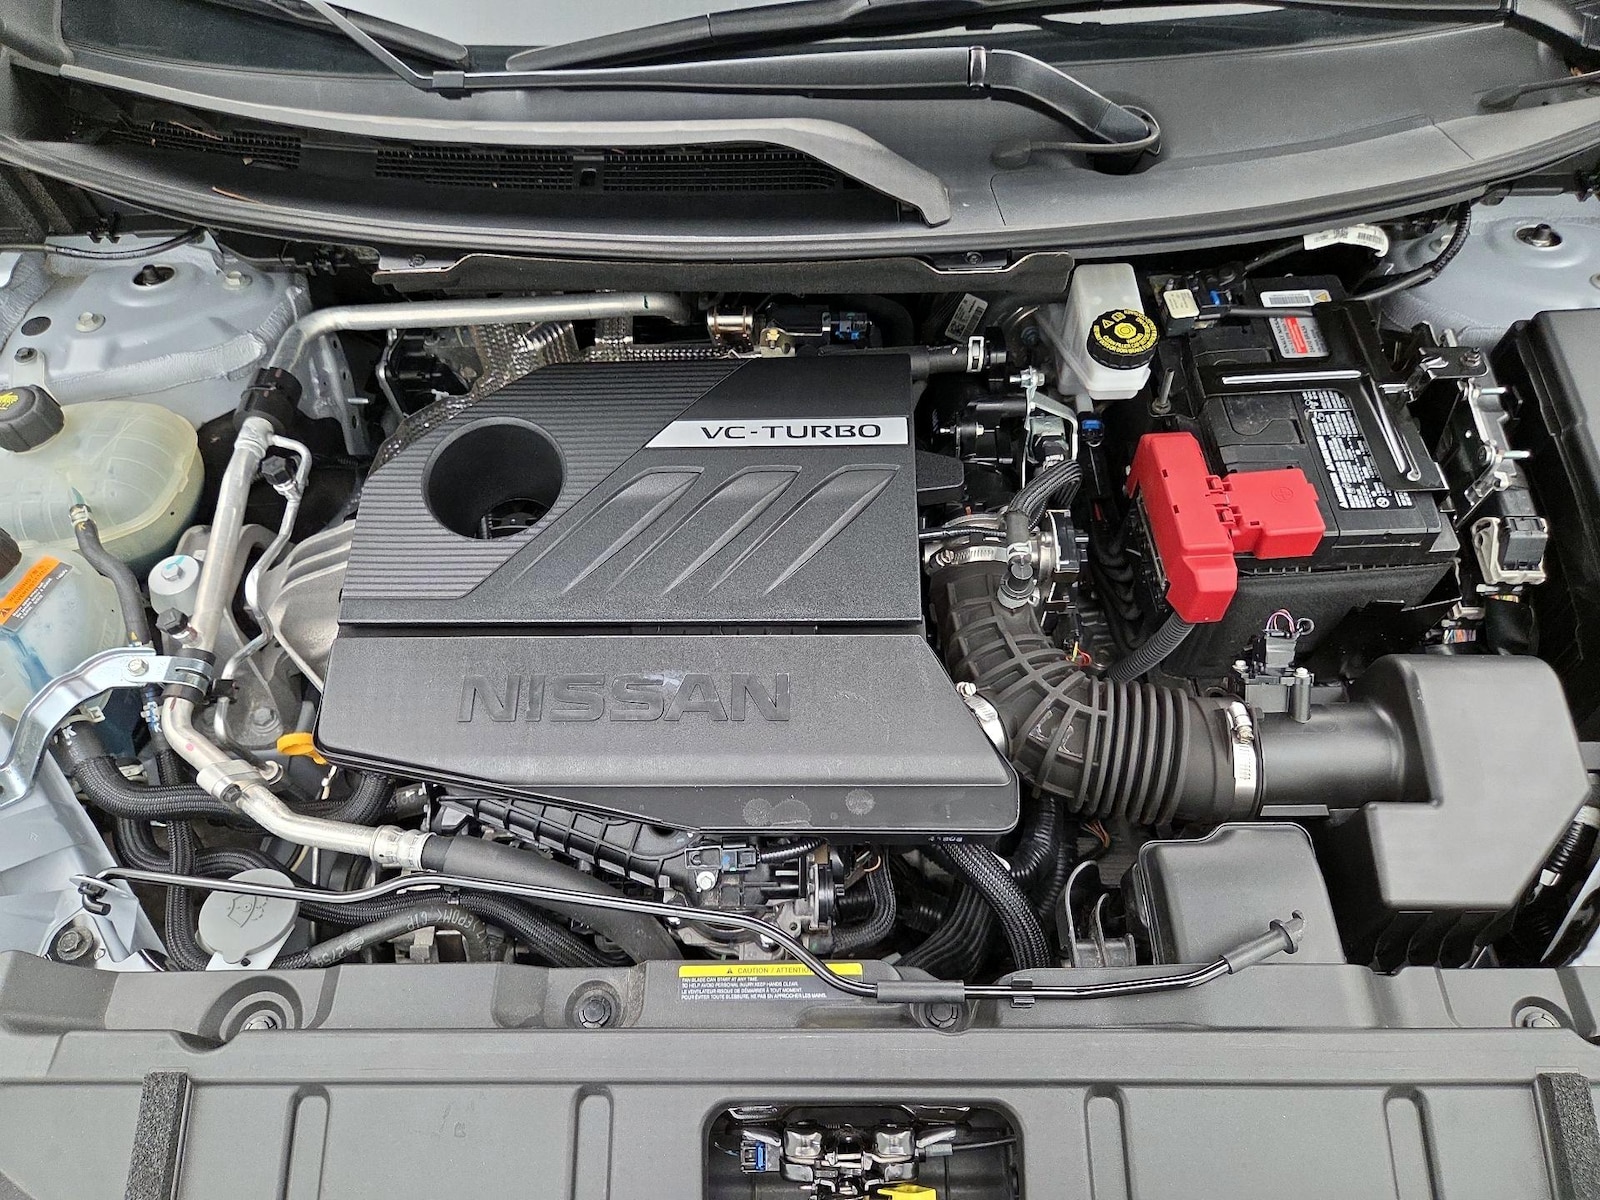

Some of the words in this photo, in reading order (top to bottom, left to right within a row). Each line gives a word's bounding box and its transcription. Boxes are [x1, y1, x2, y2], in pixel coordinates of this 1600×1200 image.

[700, 424, 882, 439] VC-TURBO
[457, 672, 791, 723] NISSAN
[738, 967, 769, 975] CAUTION
